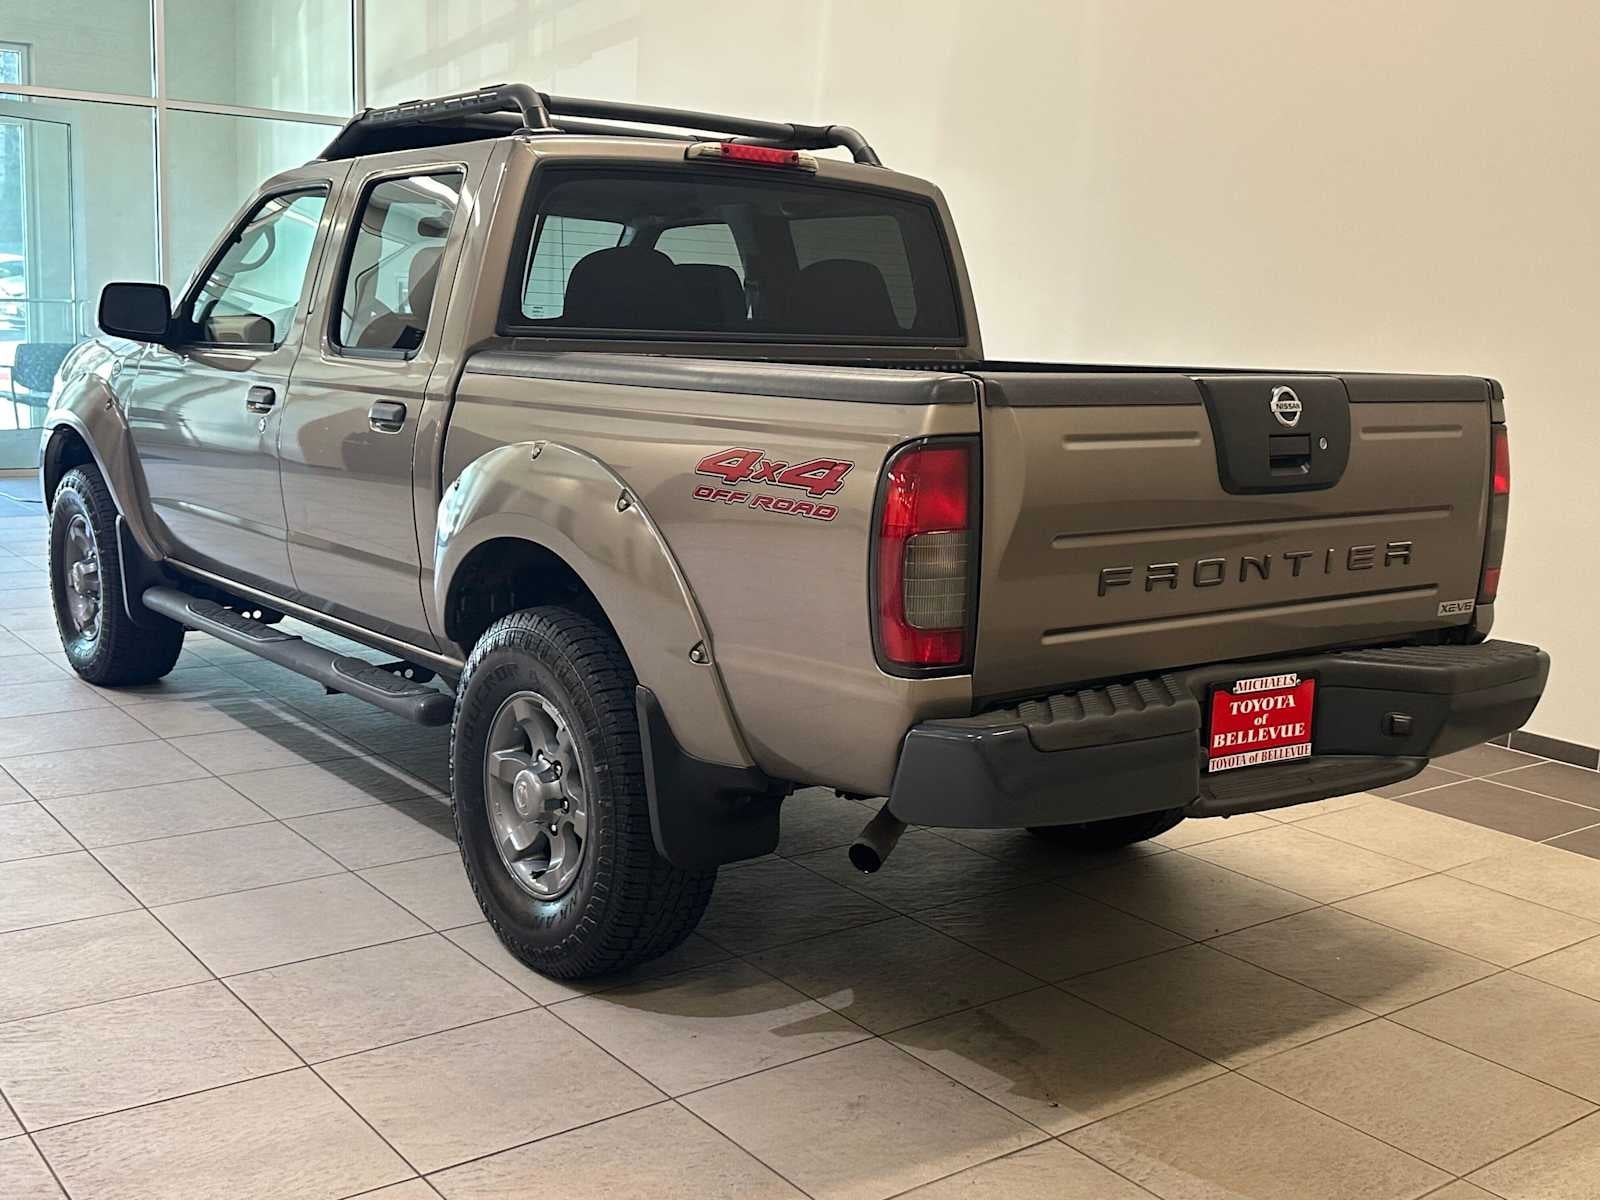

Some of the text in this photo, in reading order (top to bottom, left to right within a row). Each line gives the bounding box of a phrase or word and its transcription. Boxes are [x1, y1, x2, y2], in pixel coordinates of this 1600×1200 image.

[695, 447, 855, 498] 4x4
[693, 485, 839, 521] OFF ROAD
[1097, 541, 1414, 597] FRONTIER
[1235, 674, 1297, 692] MICHAELS
[1229, 694, 1297, 715] TOYOTA
[1253, 713, 1269, 726] of
[1213, 722, 1305, 748] BELLEVUE
[1210, 744, 1311, 771] TOYOTA of BELLEVUE
